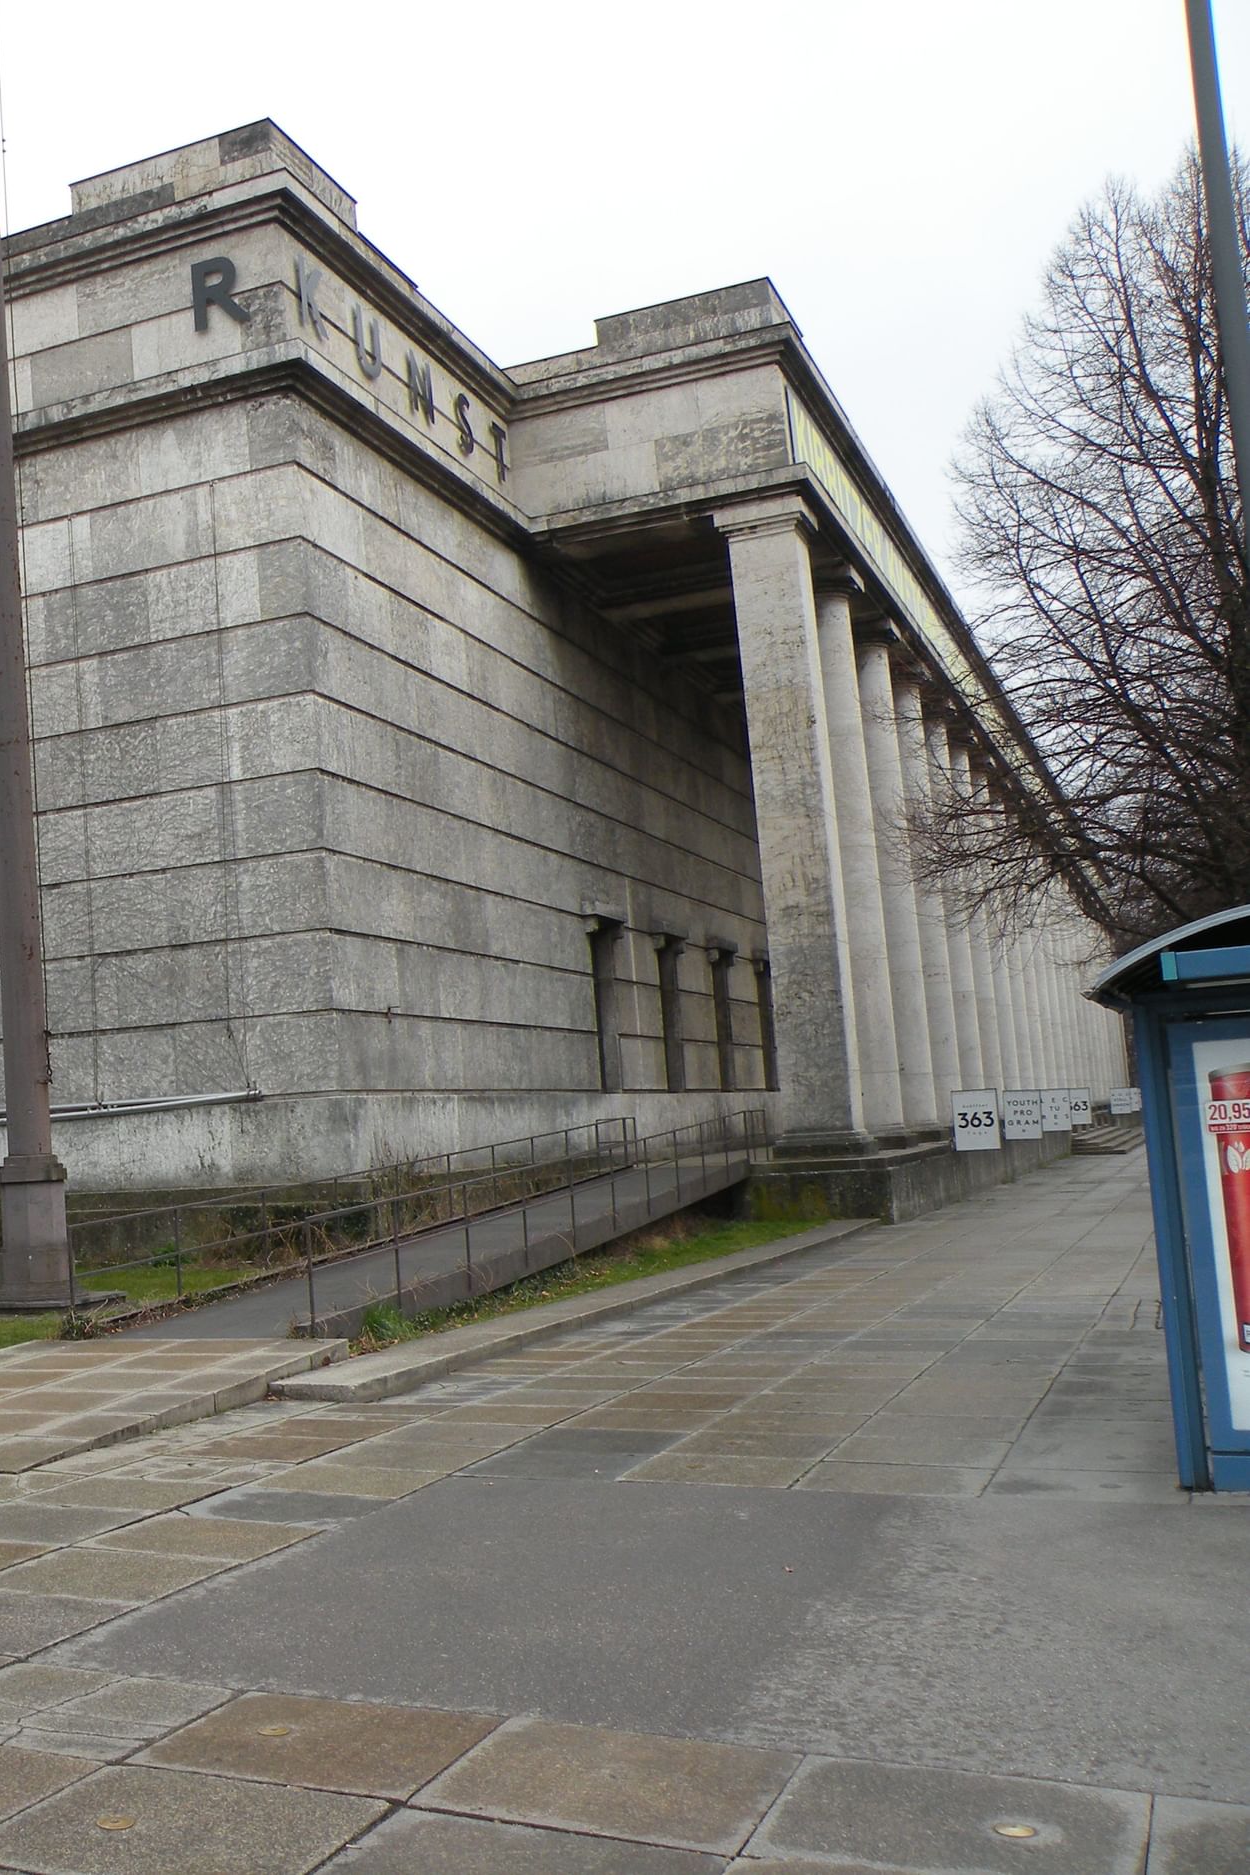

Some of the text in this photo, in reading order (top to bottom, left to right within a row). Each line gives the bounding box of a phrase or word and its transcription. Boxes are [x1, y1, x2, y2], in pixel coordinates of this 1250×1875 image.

[294, 253, 508, 482] KUNST
[957, 1110, 995, 1129] 363
[1208, 1103, 1250, 1121] 20,95
